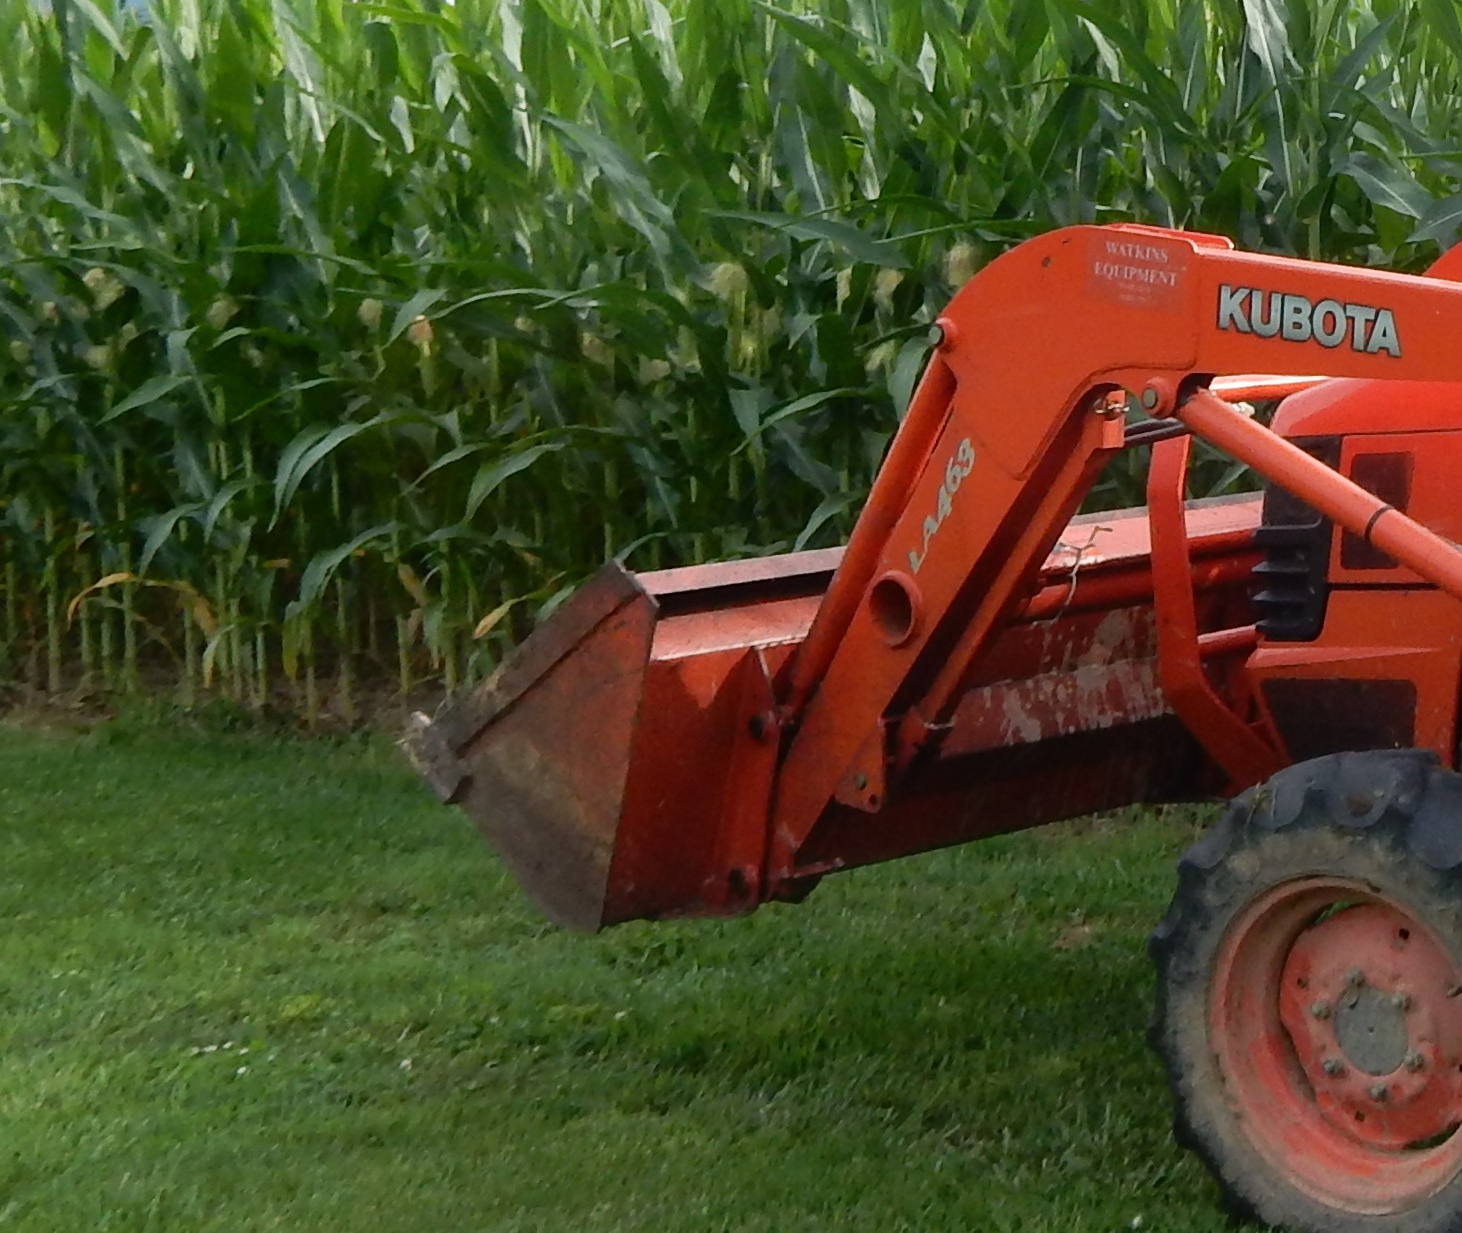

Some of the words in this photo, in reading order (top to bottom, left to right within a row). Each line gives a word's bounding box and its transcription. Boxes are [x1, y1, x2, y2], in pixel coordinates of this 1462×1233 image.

[1094, 261, 1177, 287] EQUIPMENT
[1105, 241, 1169, 263] WATKINS
[1217, 283, 1402, 358] KUBOTA
[907, 437, 976, 575] LA463
